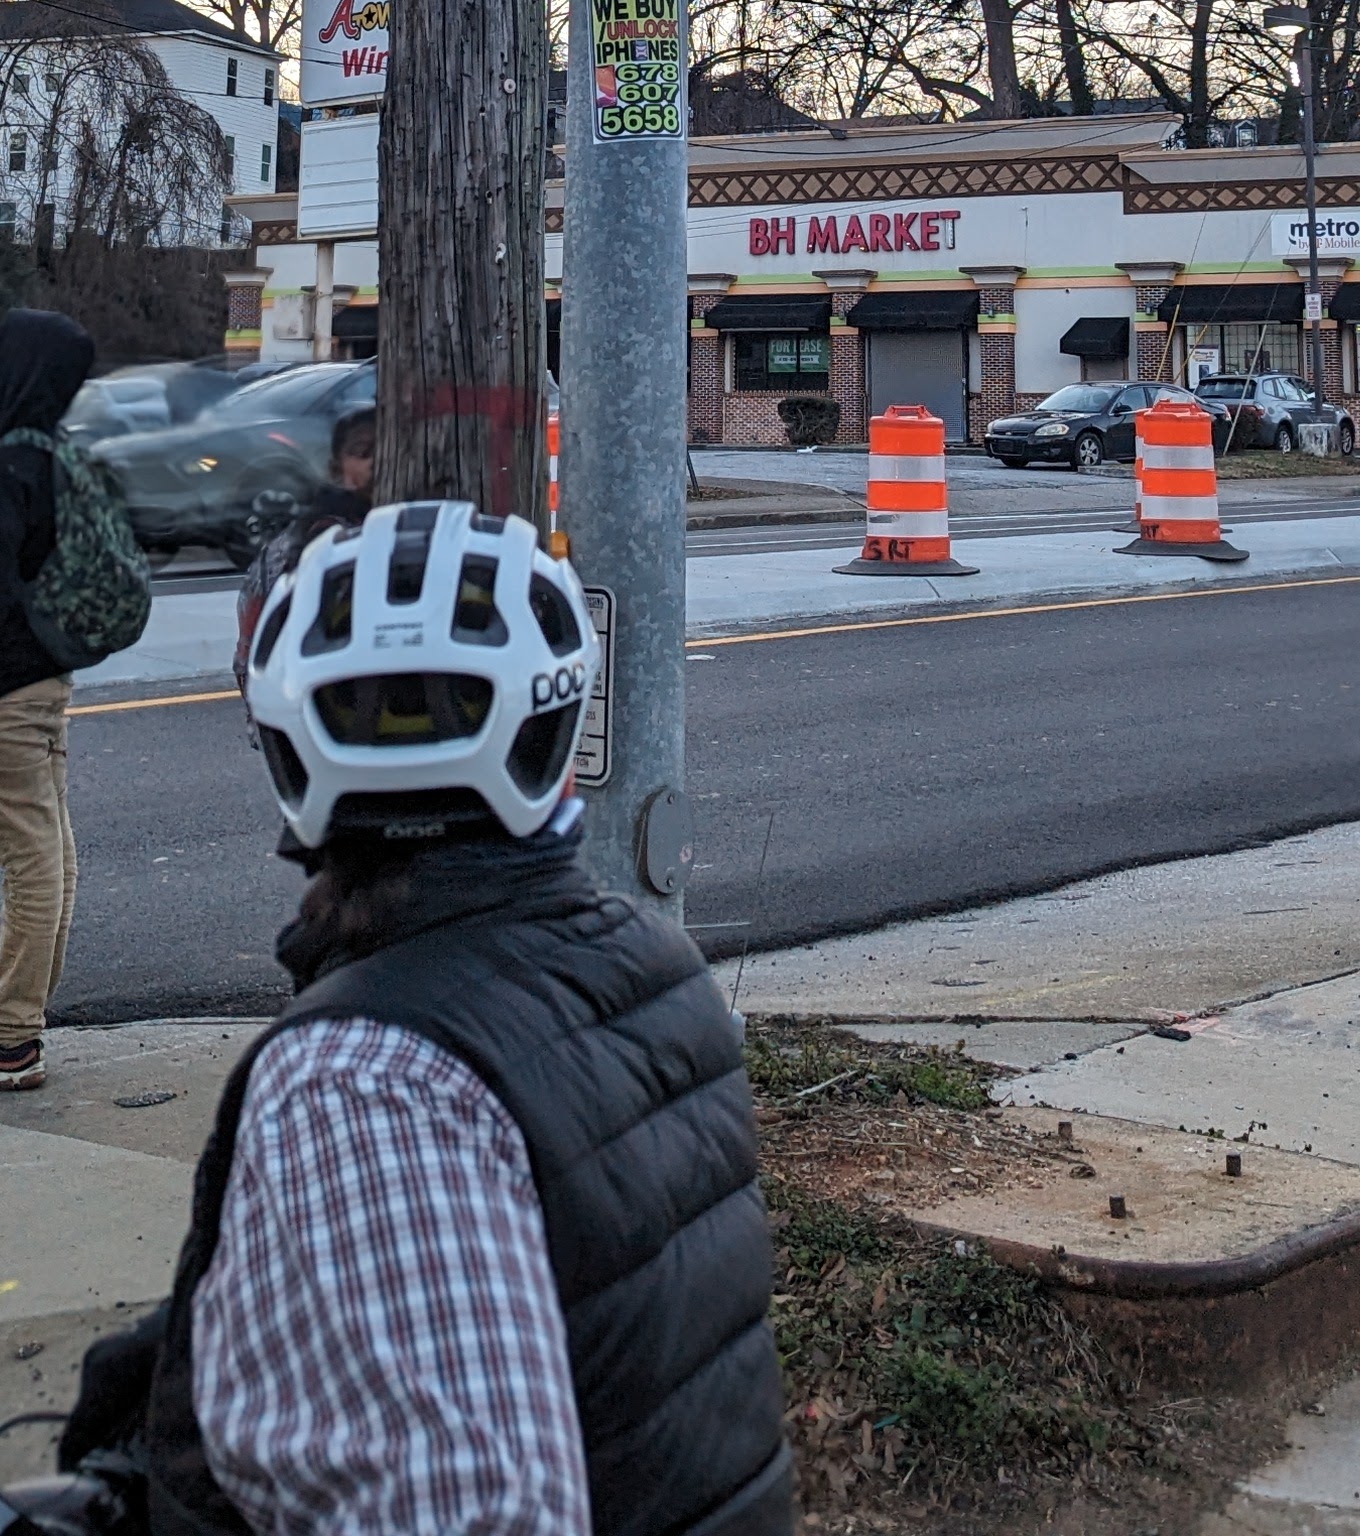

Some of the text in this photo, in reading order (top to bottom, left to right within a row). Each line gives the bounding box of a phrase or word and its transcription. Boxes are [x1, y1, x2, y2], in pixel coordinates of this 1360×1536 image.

[342, 46, 389, 78] Win
[596, 40, 678, 64] IPHNES
[615, 63, 679, 82] 678
[618, 83, 680, 103] 607
[601, 104, 680, 135] 5658
[749, 210, 960, 255] BH MARKET
[1289, 218, 1360, 242] metro
[770, 339, 822, 353] FOR LEASE
[867, 539, 915, 561] SRT
